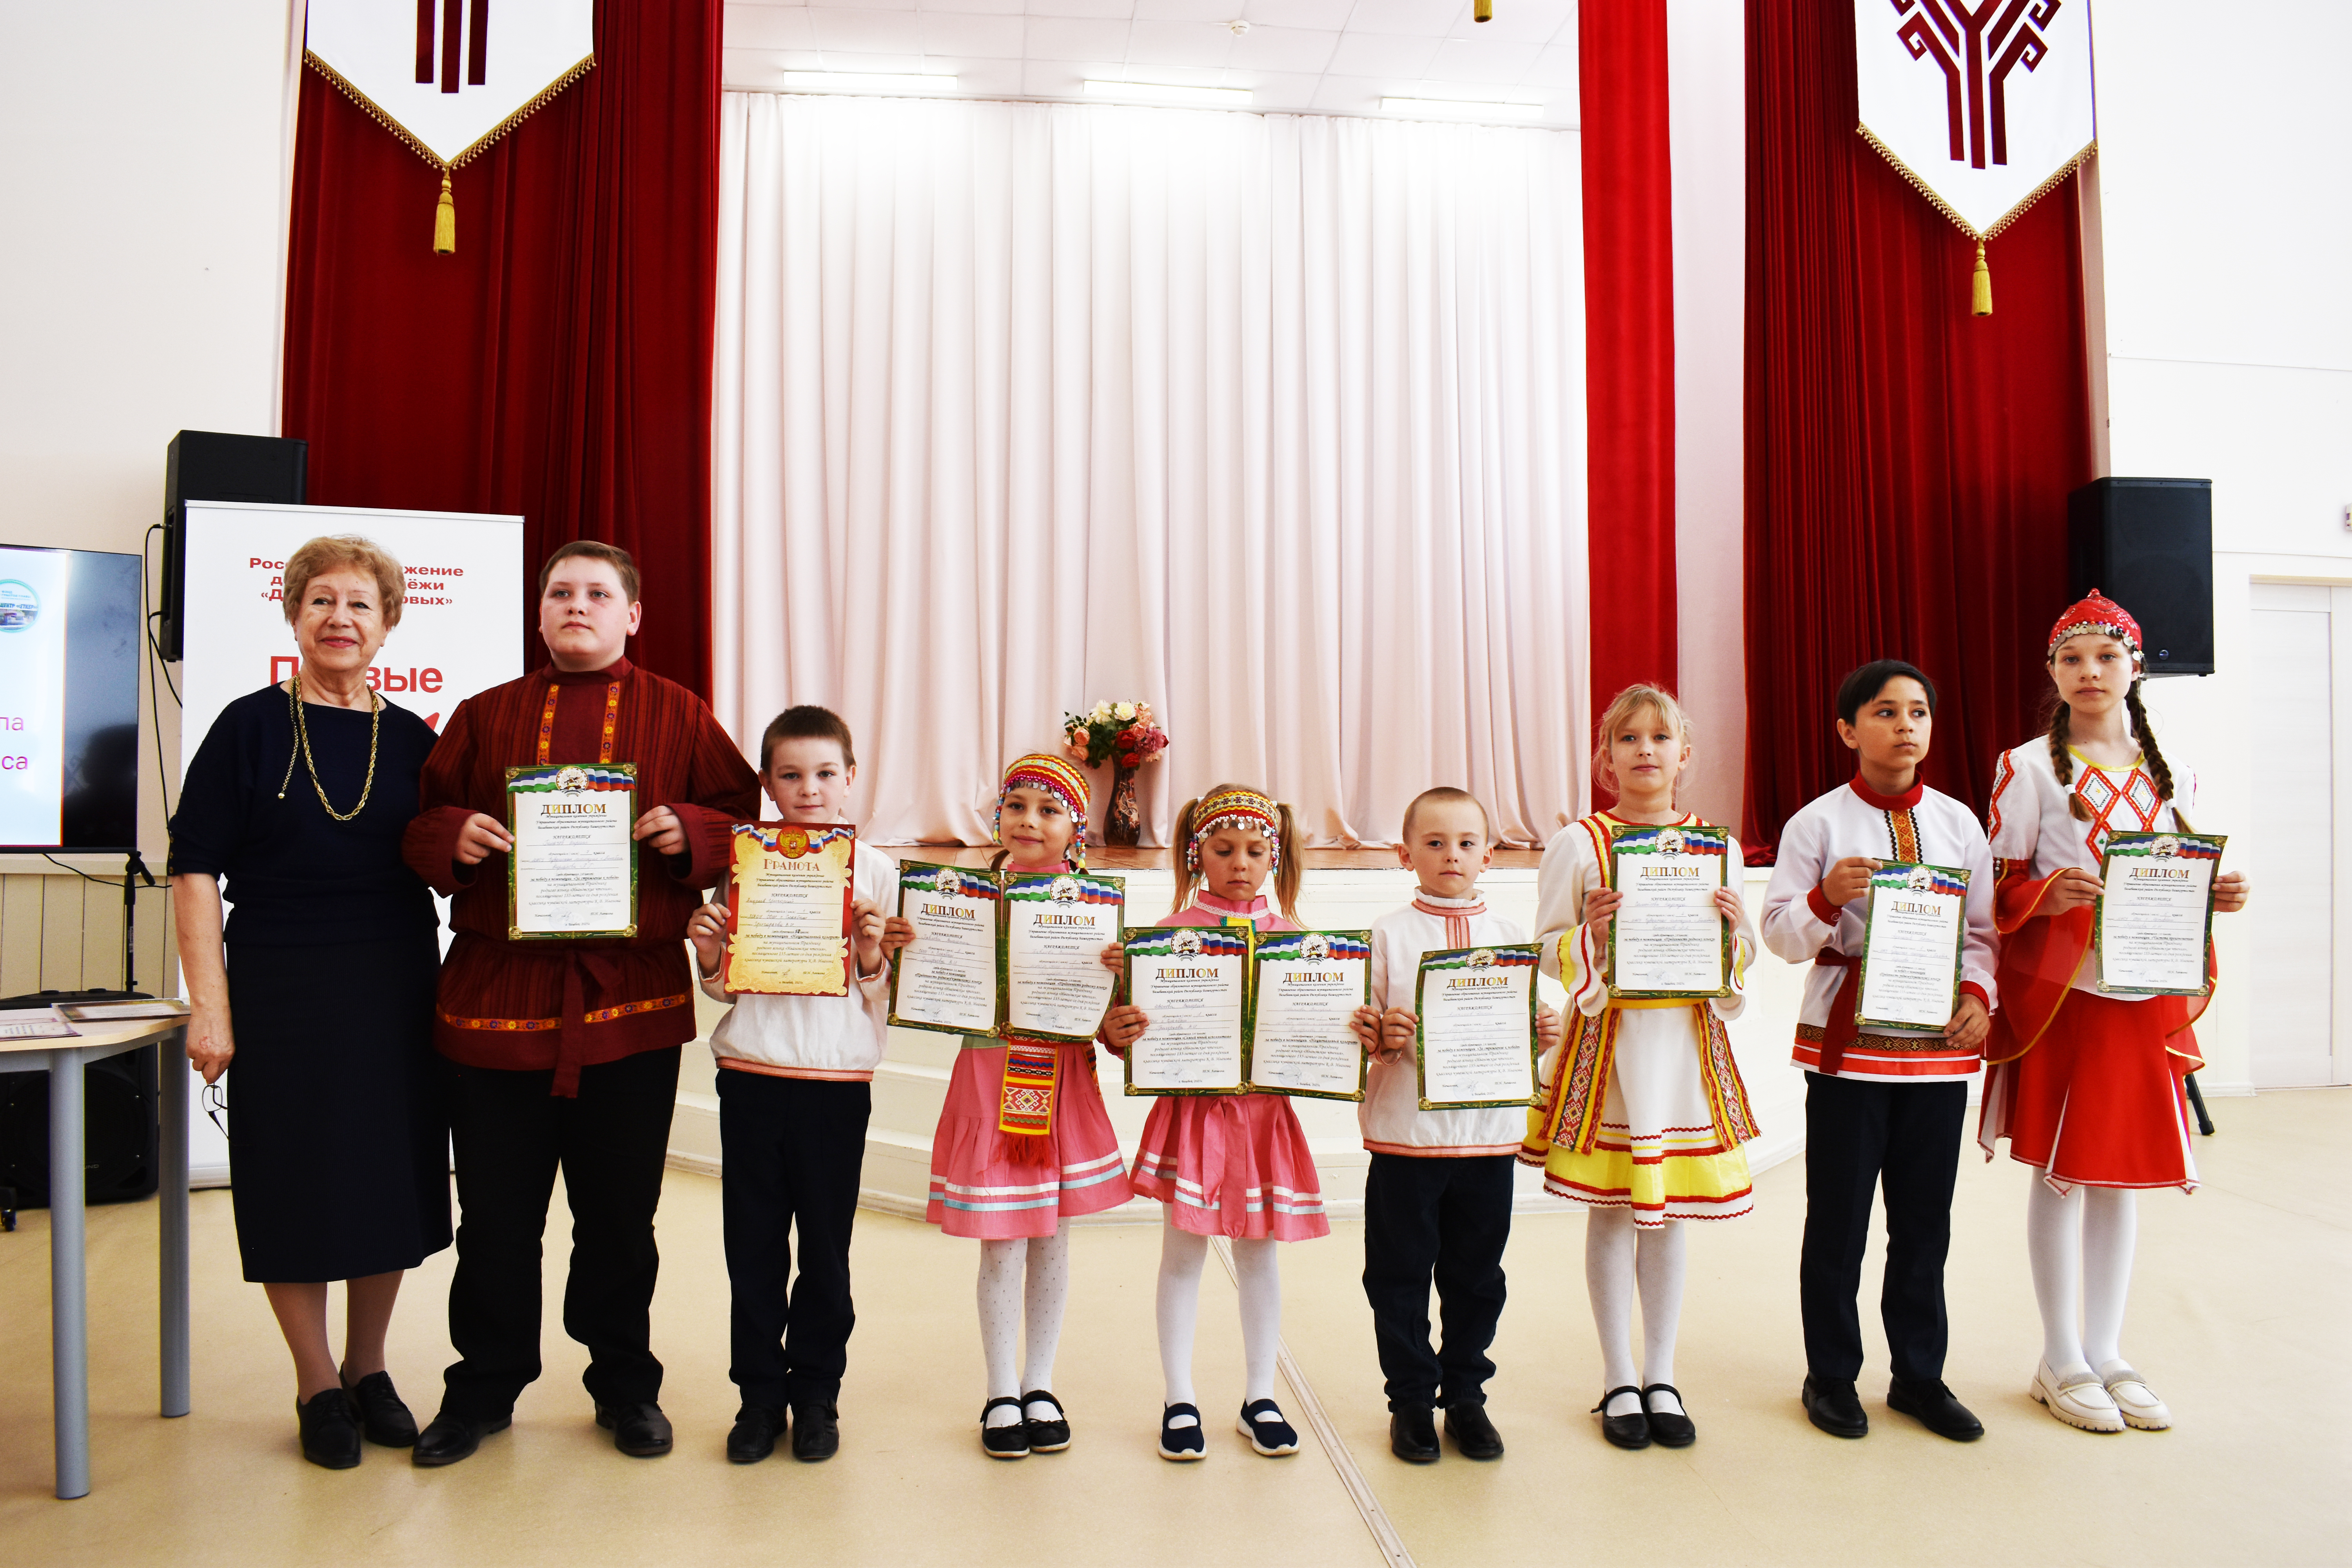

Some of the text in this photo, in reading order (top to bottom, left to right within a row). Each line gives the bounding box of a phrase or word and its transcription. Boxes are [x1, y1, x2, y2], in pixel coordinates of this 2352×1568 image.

[404, 566, 464, 577] жение
[407, 579, 445, 590] ёжи
[0, 717, 24, 731] па
[2, 756, 28, 769] са
[541, 804, 606, 816] ДИПЛОМ
[1641, 867, 1700, 878] ДИПЛОМ
[2129, 867, 2190, 878] ДИПЛОМ
[921, 904, 975, 919] ДИПЛОМ
[1891, 901, 1942, 915] ДИПЛОМ
[1033, 914, 1096, 926] ДИПЛОМ
[1156, 968, 1219, 980] ДИПЛОМ
[1283, 973, 1344, 984] ДИПЛОМ
[1446, 977, 1508, 989] ДИПЛОМ
